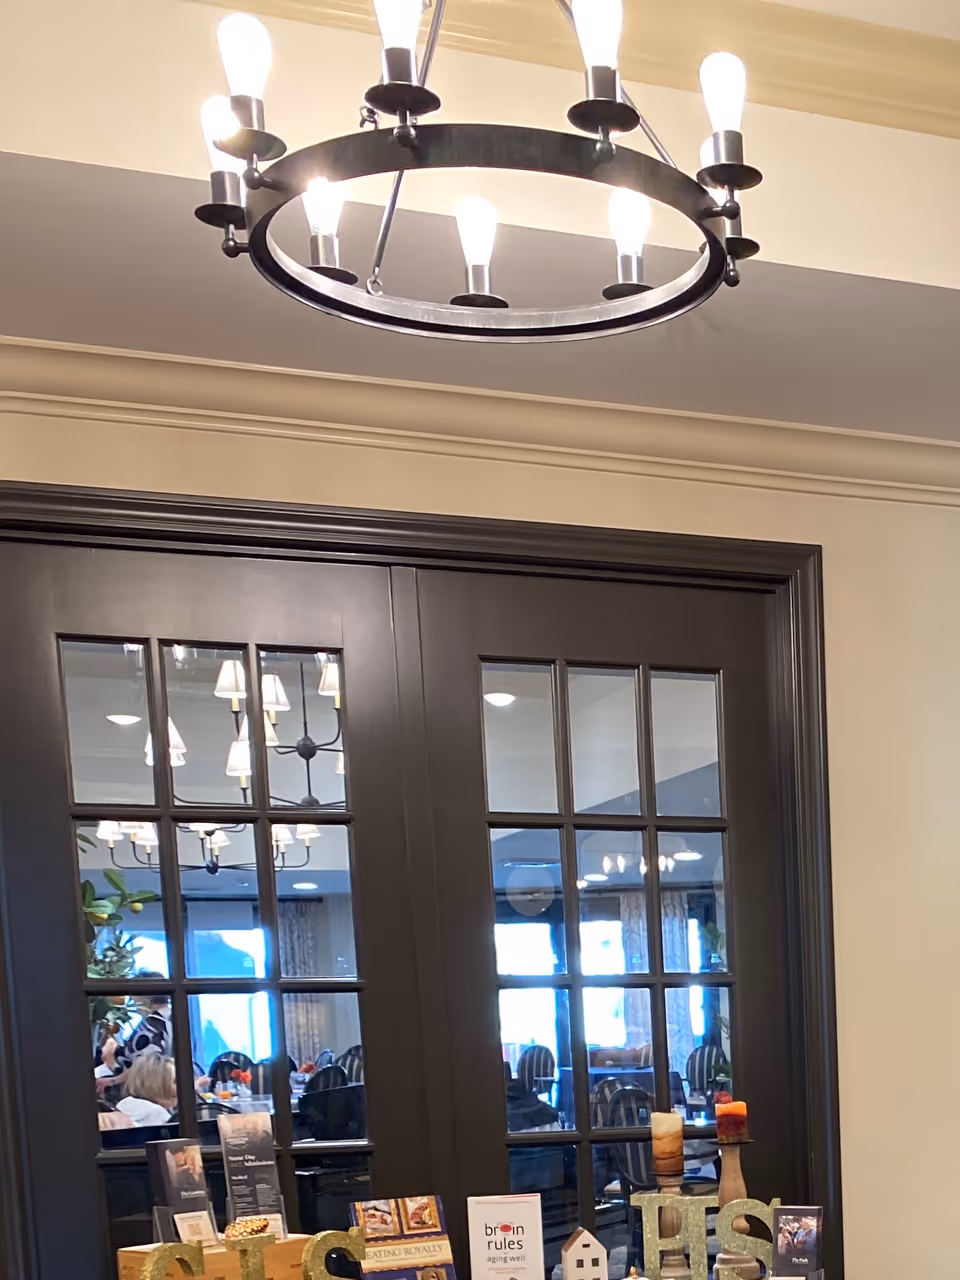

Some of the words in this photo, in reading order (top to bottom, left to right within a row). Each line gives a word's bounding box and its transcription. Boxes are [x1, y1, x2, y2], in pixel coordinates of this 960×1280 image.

[485, 1222, 525, 1237] brin
[487, 1237, 524, 1251] rules
[366, 1247, 402, 1260] EATING
[403, 1243, 444, 1256] ROYALLY
[487, 1256, 508, 1264] aging
[509, 1254, 526, 1262] well
